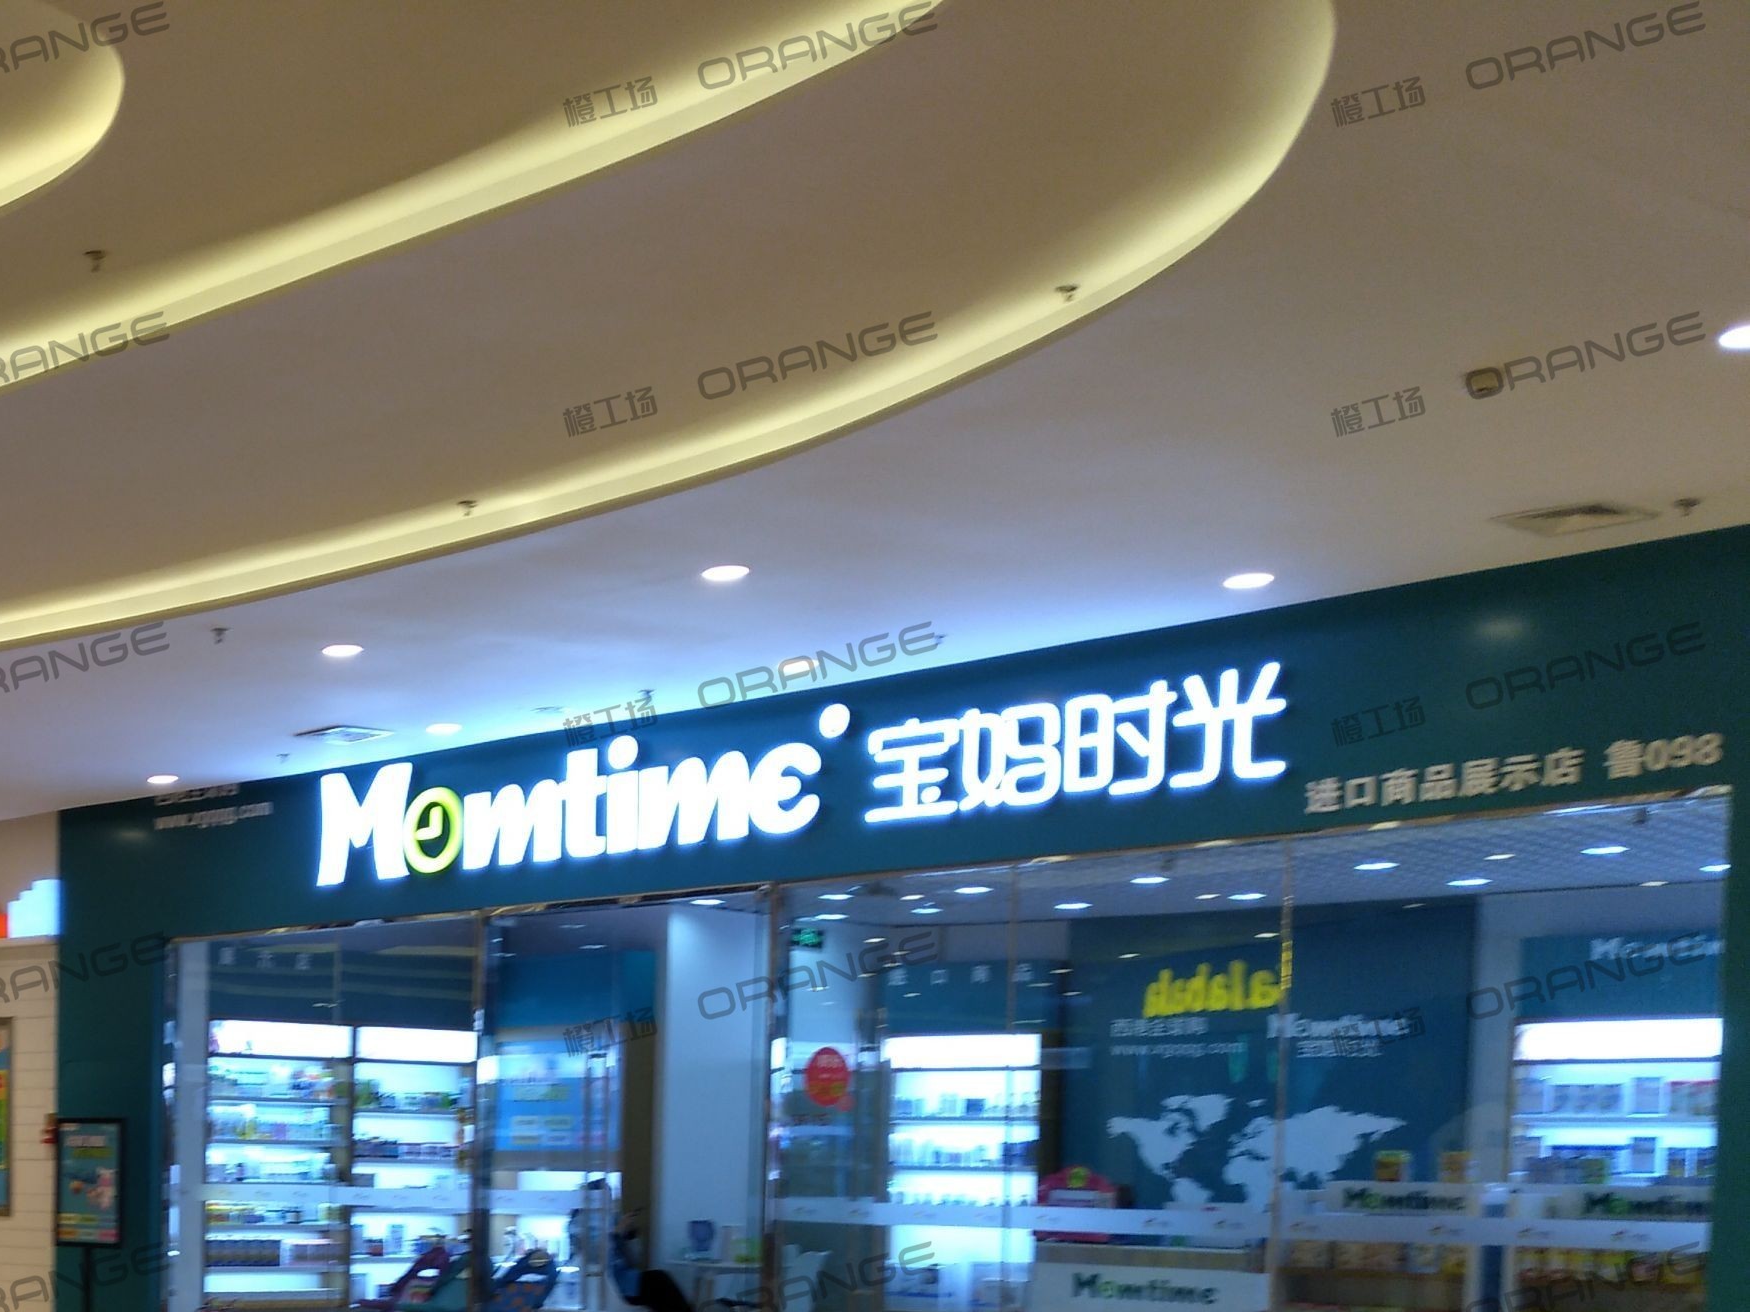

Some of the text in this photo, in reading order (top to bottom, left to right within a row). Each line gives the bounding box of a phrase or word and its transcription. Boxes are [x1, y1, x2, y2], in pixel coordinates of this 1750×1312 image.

[316, 740, 823, 888] Momtime
[863, 660, 1287, 824] 宝妈时光
[1304, 747, 1585, 815] 进口商品展示店
